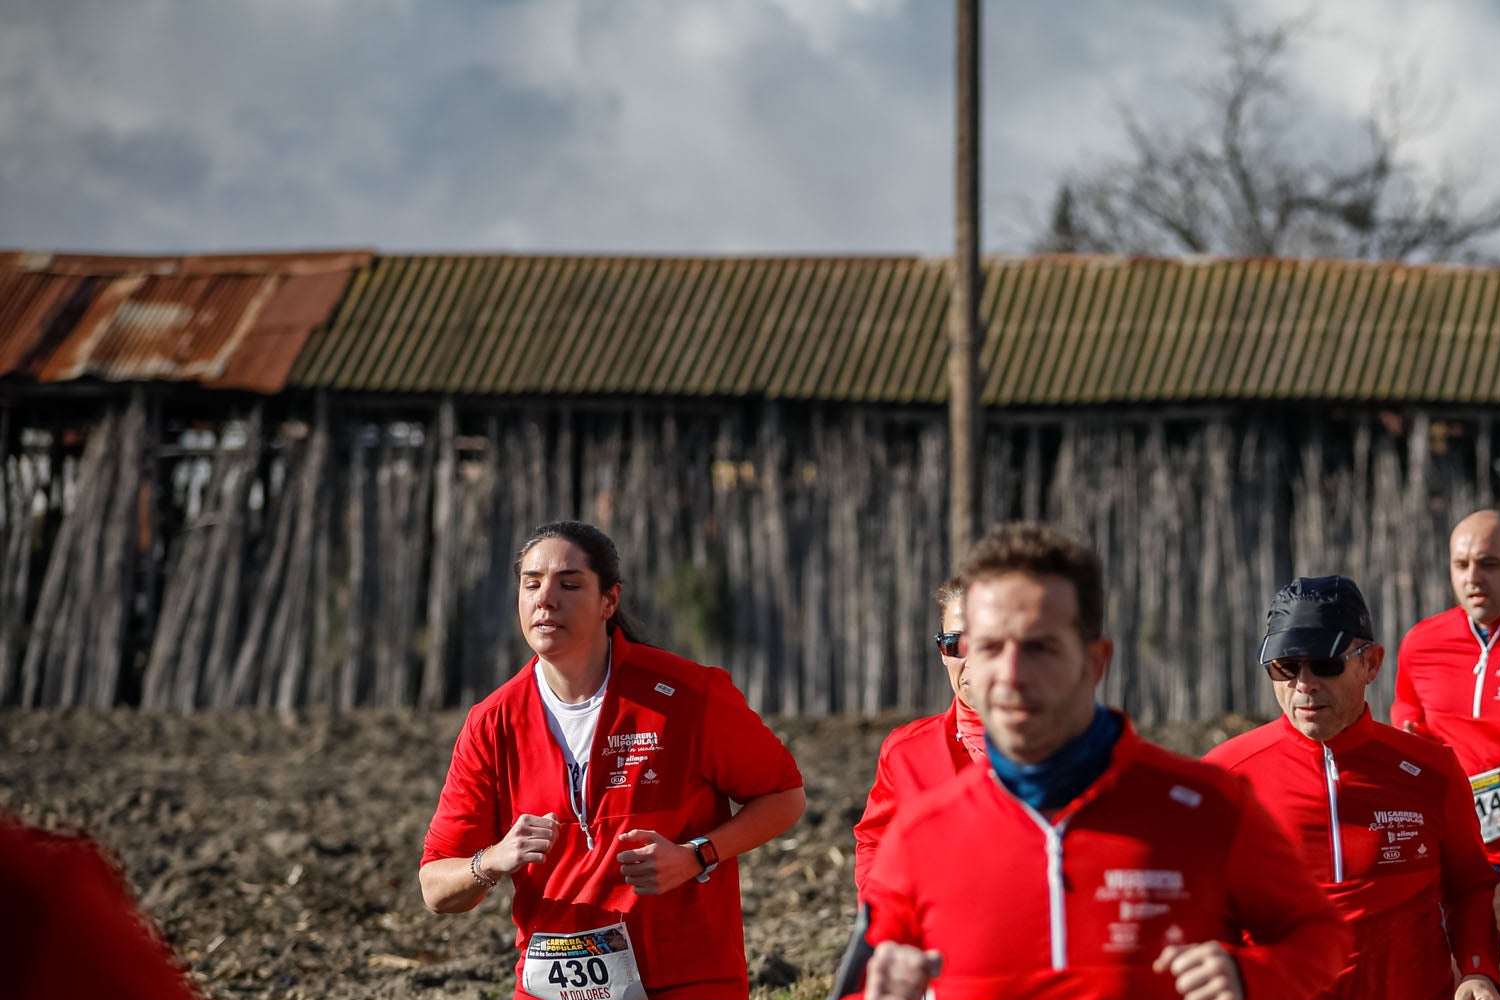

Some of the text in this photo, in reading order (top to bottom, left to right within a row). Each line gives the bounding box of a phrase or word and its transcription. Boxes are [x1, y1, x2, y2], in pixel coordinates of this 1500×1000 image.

[608, 732, 658, 748] VII CARRERA
[620, 738, 658, 746] POPULAR
[1374, 811, 1387, 823] VII
[1388, 817, 1424, 826] POPULAR
[548, 958, 608, 988] 430
